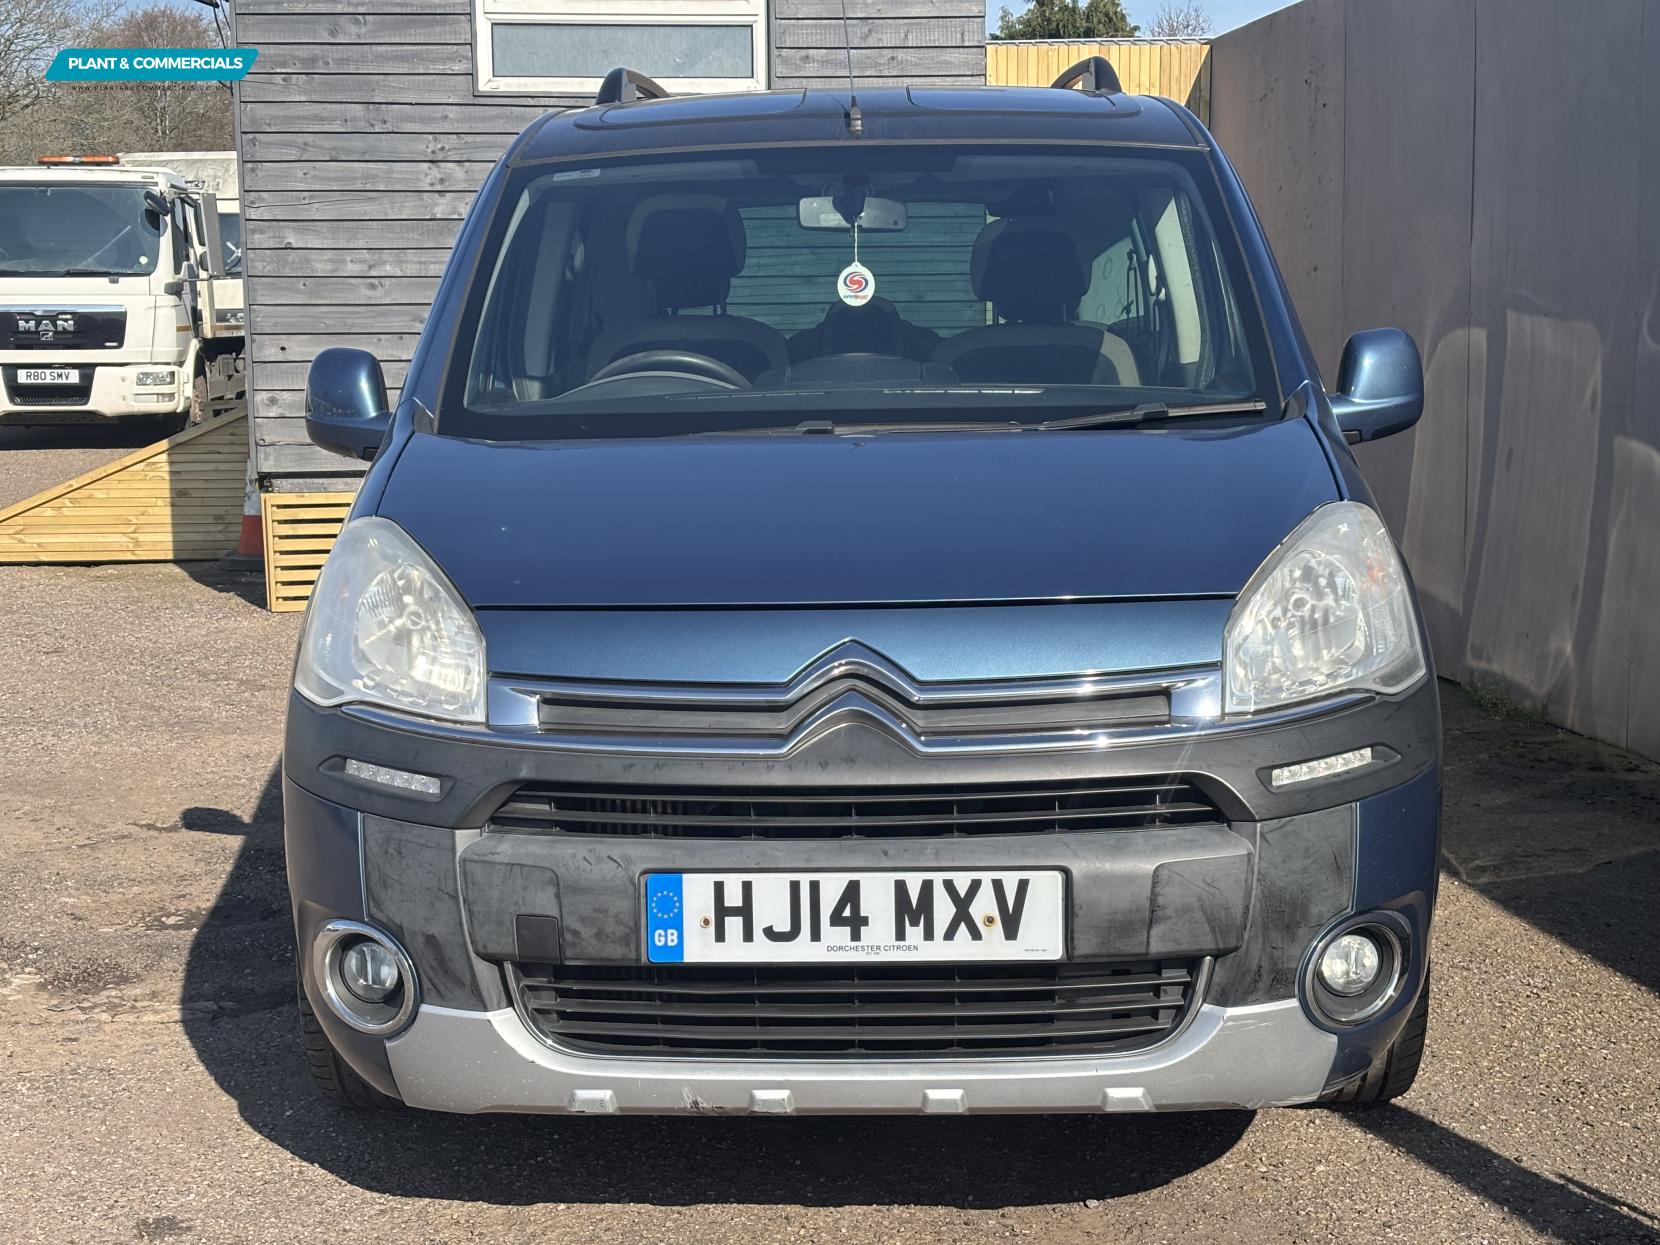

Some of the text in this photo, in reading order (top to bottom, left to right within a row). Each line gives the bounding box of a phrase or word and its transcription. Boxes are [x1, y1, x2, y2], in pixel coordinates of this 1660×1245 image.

[18, 320, 74, 331] MAN
[25, 371, 70, 381] R80 SMV
[713, 878, 1031, 943] HJ14 MXV
[653, 928, 679, 947] GB
[826, 944, 919, 953] DORCHESTER CITROEN
